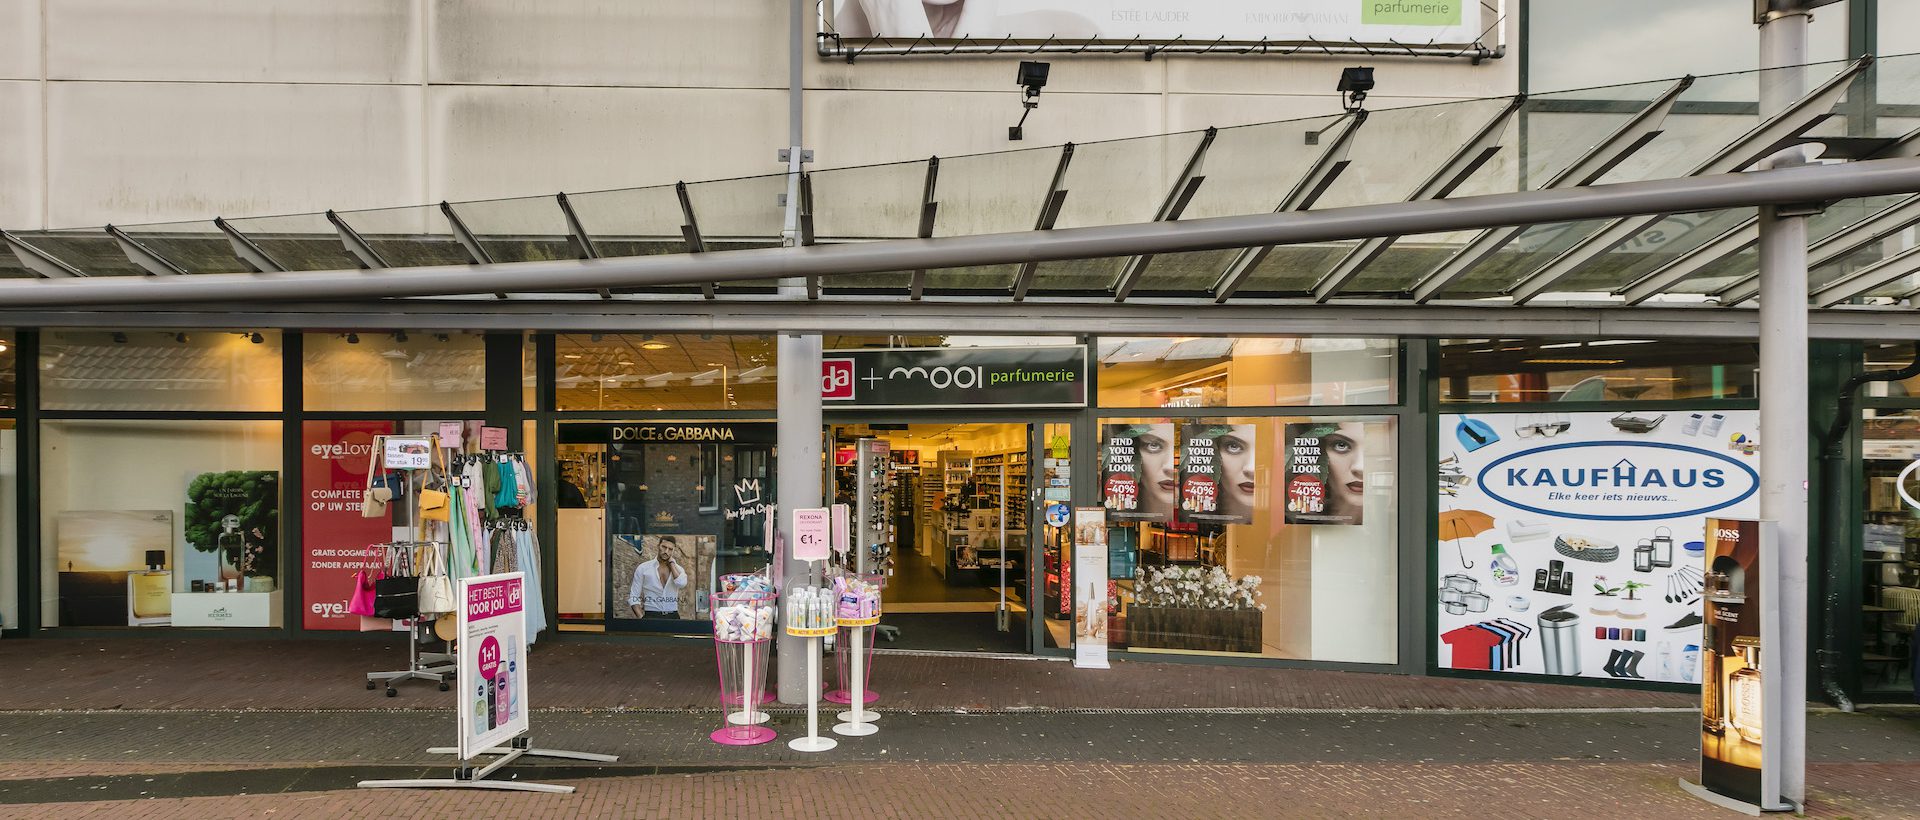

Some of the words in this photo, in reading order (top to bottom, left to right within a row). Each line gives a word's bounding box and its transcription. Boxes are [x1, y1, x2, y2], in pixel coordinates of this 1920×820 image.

[1374, 0, 1449, 15] parfumerie
[1146, 11, 1190, 23] LAUDER
[822, 366, 849, 393] da
[990, 369, 1075, 386] parfumerie
[613, 427, 656, 440] DOLCE
[665, 427, 735, 440] GABBANA
[1110, 438, 1133, 446] FIND
[1190, 438, 1213, 447] FIND
[1294, 437, 1319, 446] FIND
[1109, 447, 1135, 455] YOUR
[1188, 447, 1214, 456] YOUR
[1293, 447, 1321, 455] YOUR
[1110, 456, 1133, 464] NEW
[1190, 457, 1213, 465] NEW
[1294, 456, 1319, 464] NEW
[1109, 464, 1135, 472] LOOK
[1187, 465, 1214, 474] LOOK
[1292, 465, 1320, 473] LOOK
[1507, 458, 1725, 488] KAUFHAUS
[311, 489, 361, 499] COMPLETE
[1548, 492, 1571, 500] Elke
[1574, 493, 1599, 501] keer
[1602, 493, 1623, 501] iets
[1626, 494, 1677, 502] nieuws...
[311, 502, 326, 511] OP
[328, 502, 344, 511] UW
[800, 534, 822, 546] €1,-
[469, 589, 482, 602] HET
[483, 586, 503, 600] BESTE
[510, 587, 520, 604] da
[469, 601, 489, 615] VOOR
[490, 599, 504, 615] JOU
[482, 644, 496, 663] 1+1
[482, 661, 497, 671] GRATIS
